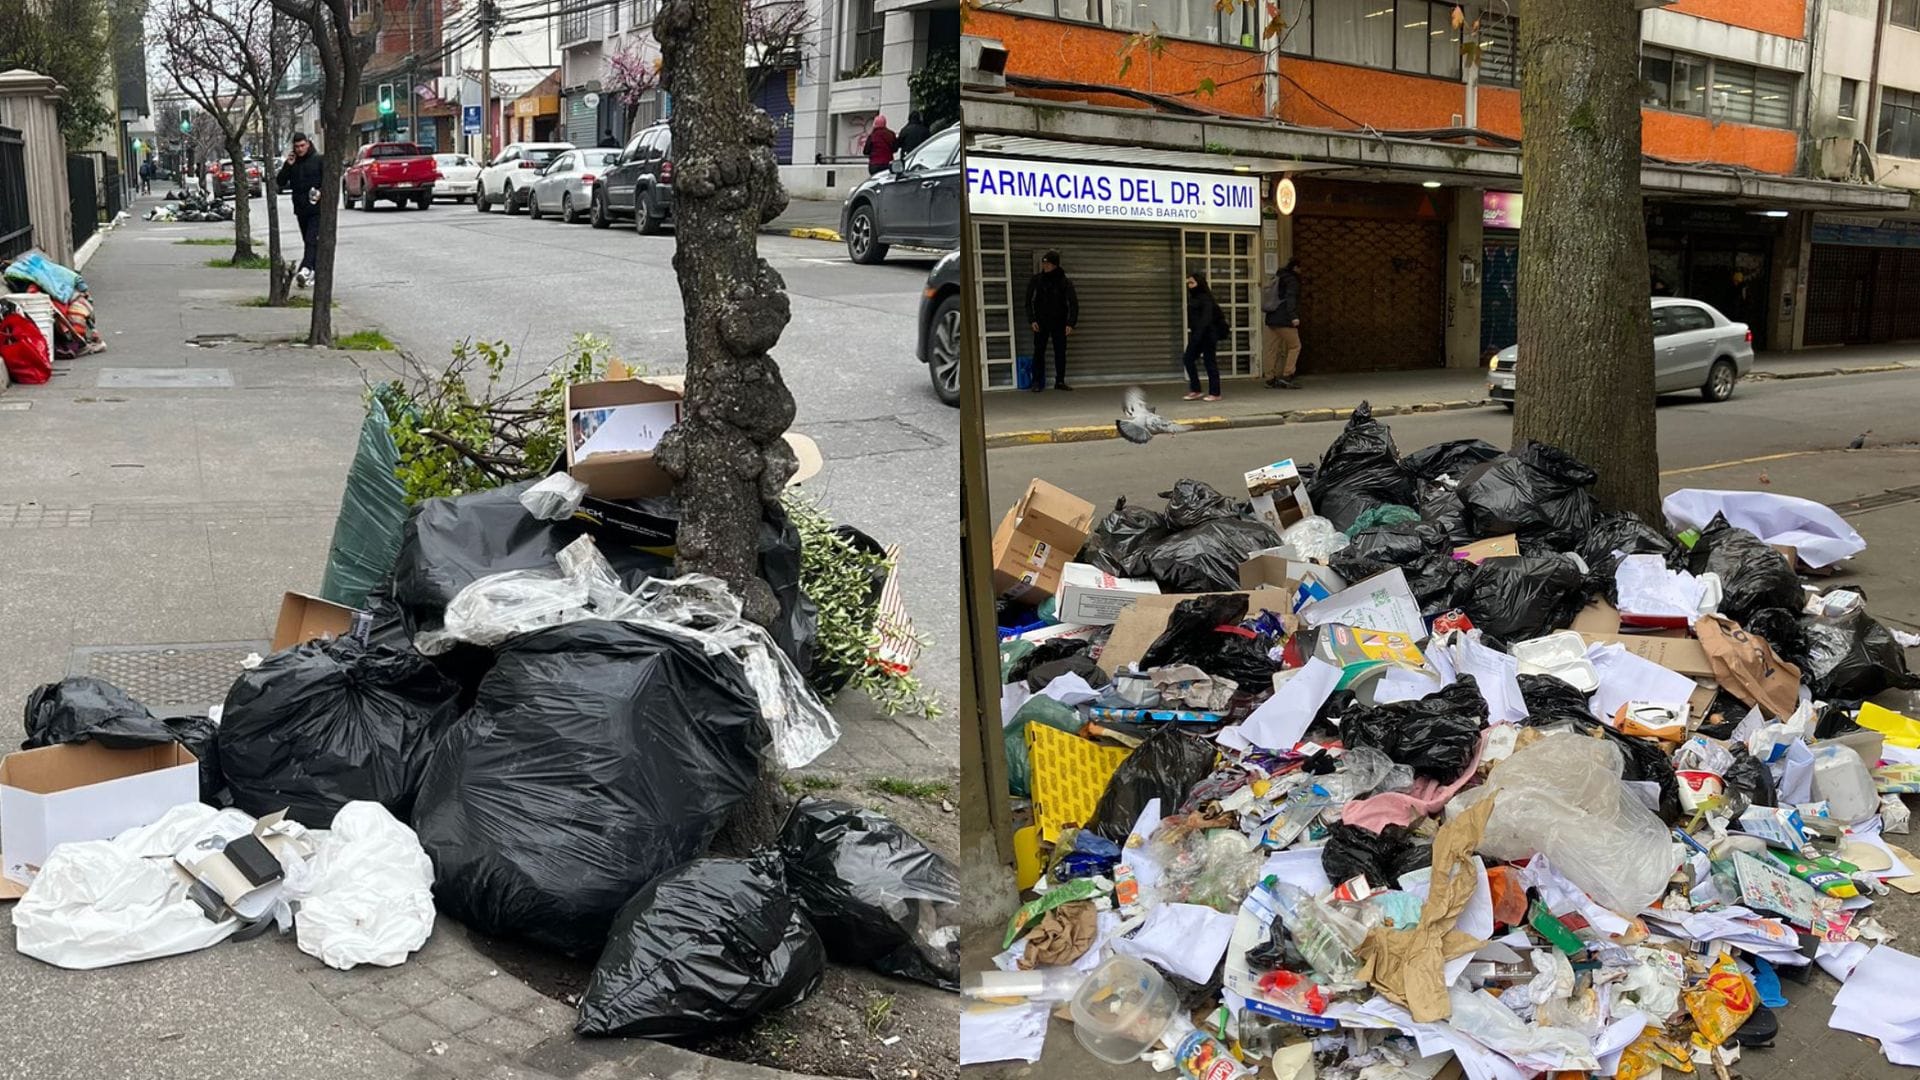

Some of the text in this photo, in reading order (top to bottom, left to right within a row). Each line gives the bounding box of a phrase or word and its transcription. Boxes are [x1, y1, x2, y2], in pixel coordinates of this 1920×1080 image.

[966, 167, 1253, 208] FARMACIAS DEL DR. SIMI
[1057, 203, 1095, 214] MISMO
[1097, 205, 1128, 216] PERO
[1130, 206, 1154, 217] MAS
